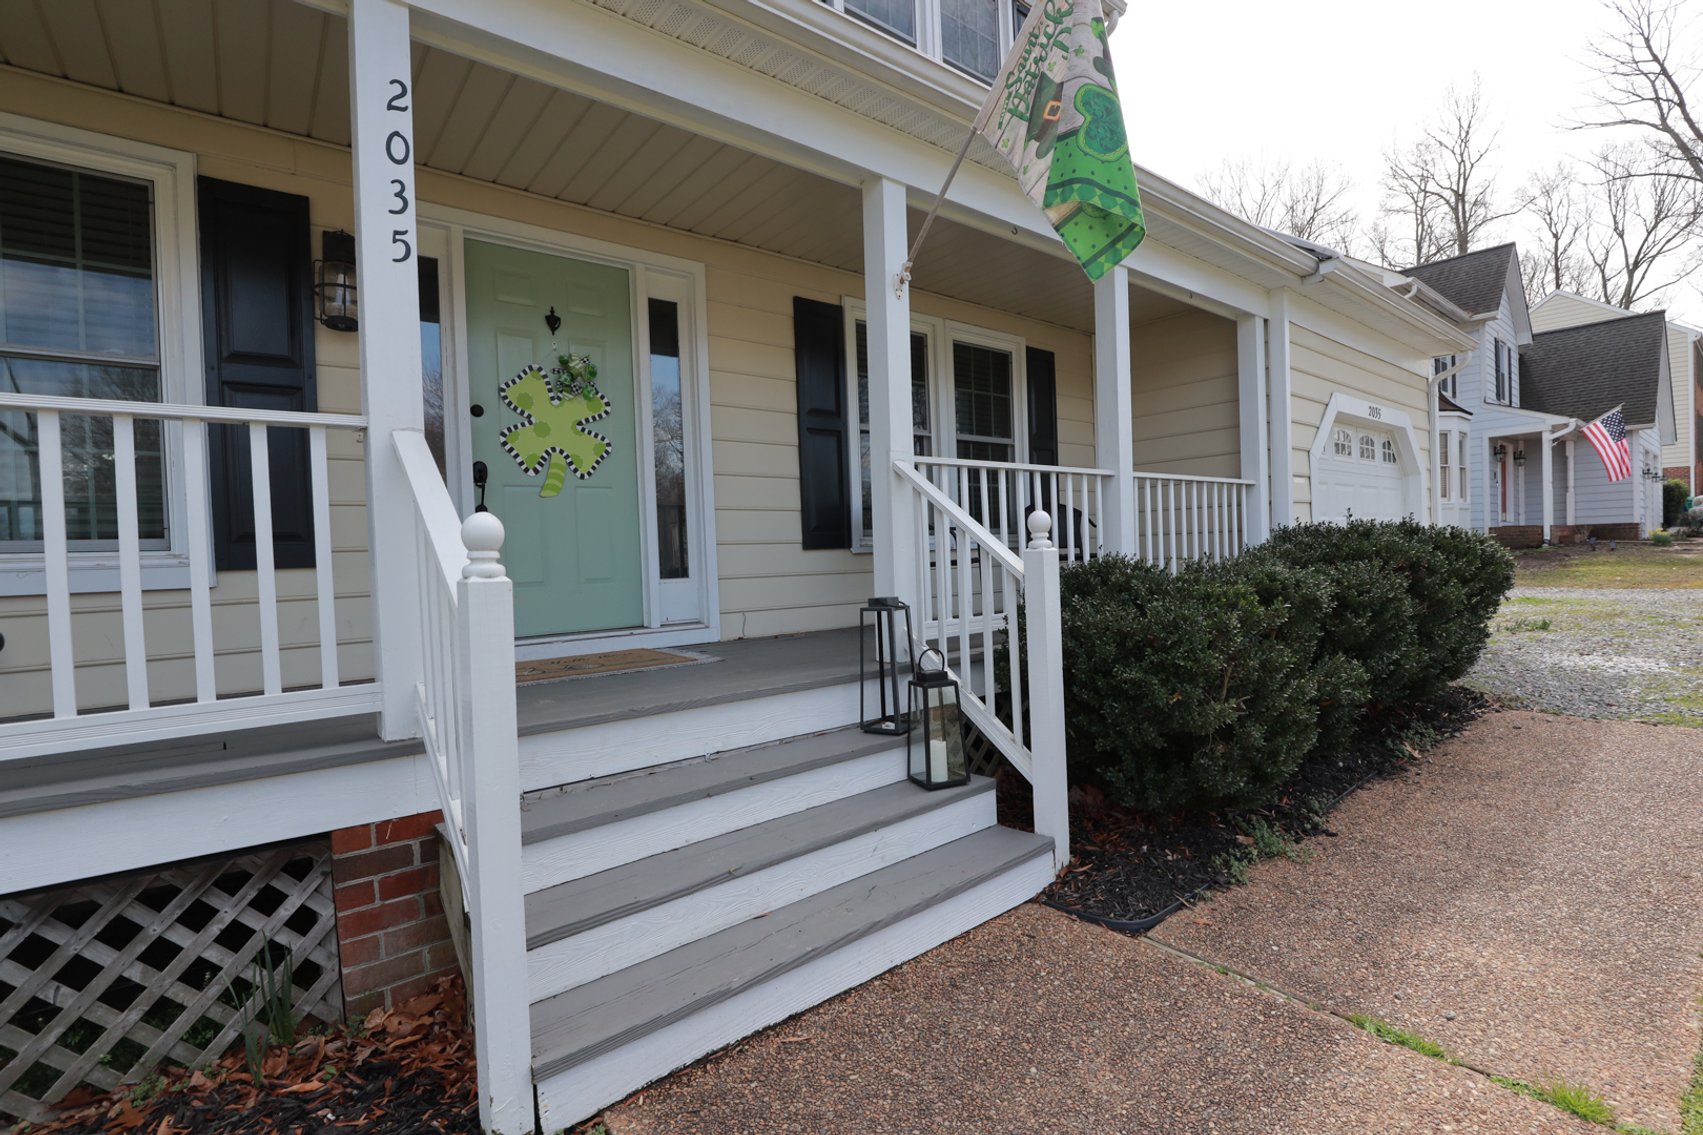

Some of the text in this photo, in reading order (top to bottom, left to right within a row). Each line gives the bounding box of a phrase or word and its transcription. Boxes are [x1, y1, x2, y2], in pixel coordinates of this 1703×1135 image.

[1005, 26, 1041, 94] Saint
[386, 79, 412, 263] 2035
[1368, 405, 1382, 420] 2035
